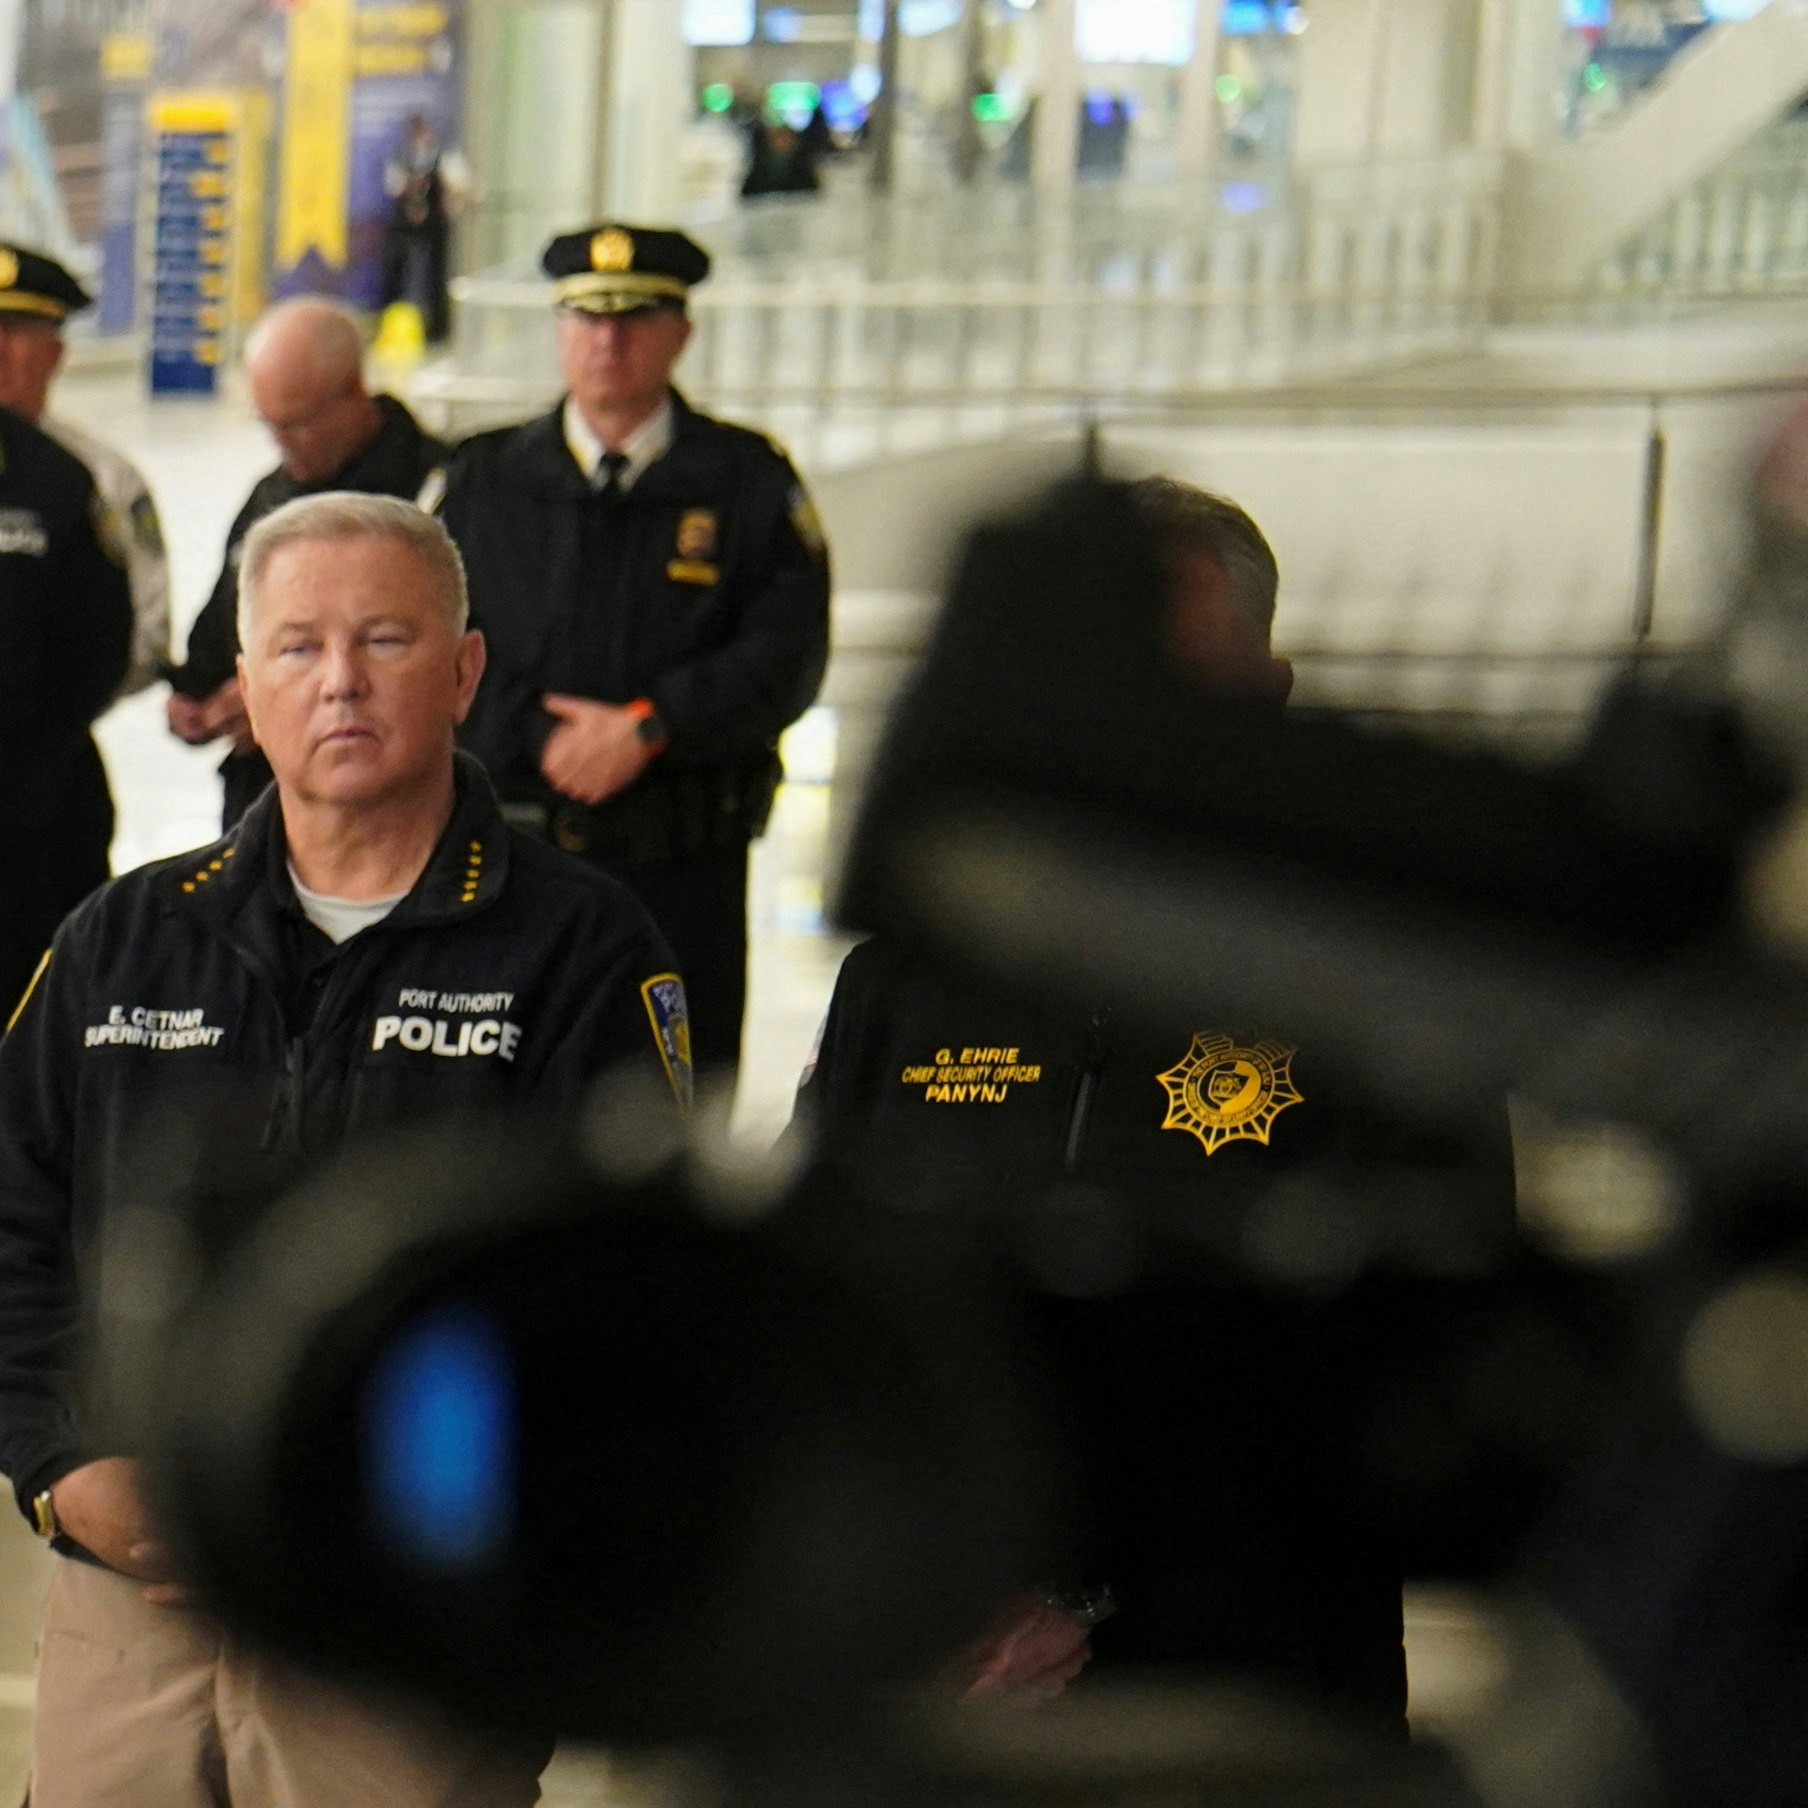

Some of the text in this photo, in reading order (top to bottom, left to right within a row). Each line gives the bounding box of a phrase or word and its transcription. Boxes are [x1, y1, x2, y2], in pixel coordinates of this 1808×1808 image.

[398, 988, 515, 1013] PORT AUTHORITY
[131, 1005, 204, 1031] CETNAR
[372, 1015, 523, 1063] POLICE
[960, 1047, 1020, 1065] EHRIE
[902, 1064, 1041, 1084] CHIEF SECURITY OFFICER
[925, 1083, 1008, 1103] PANYNJ
